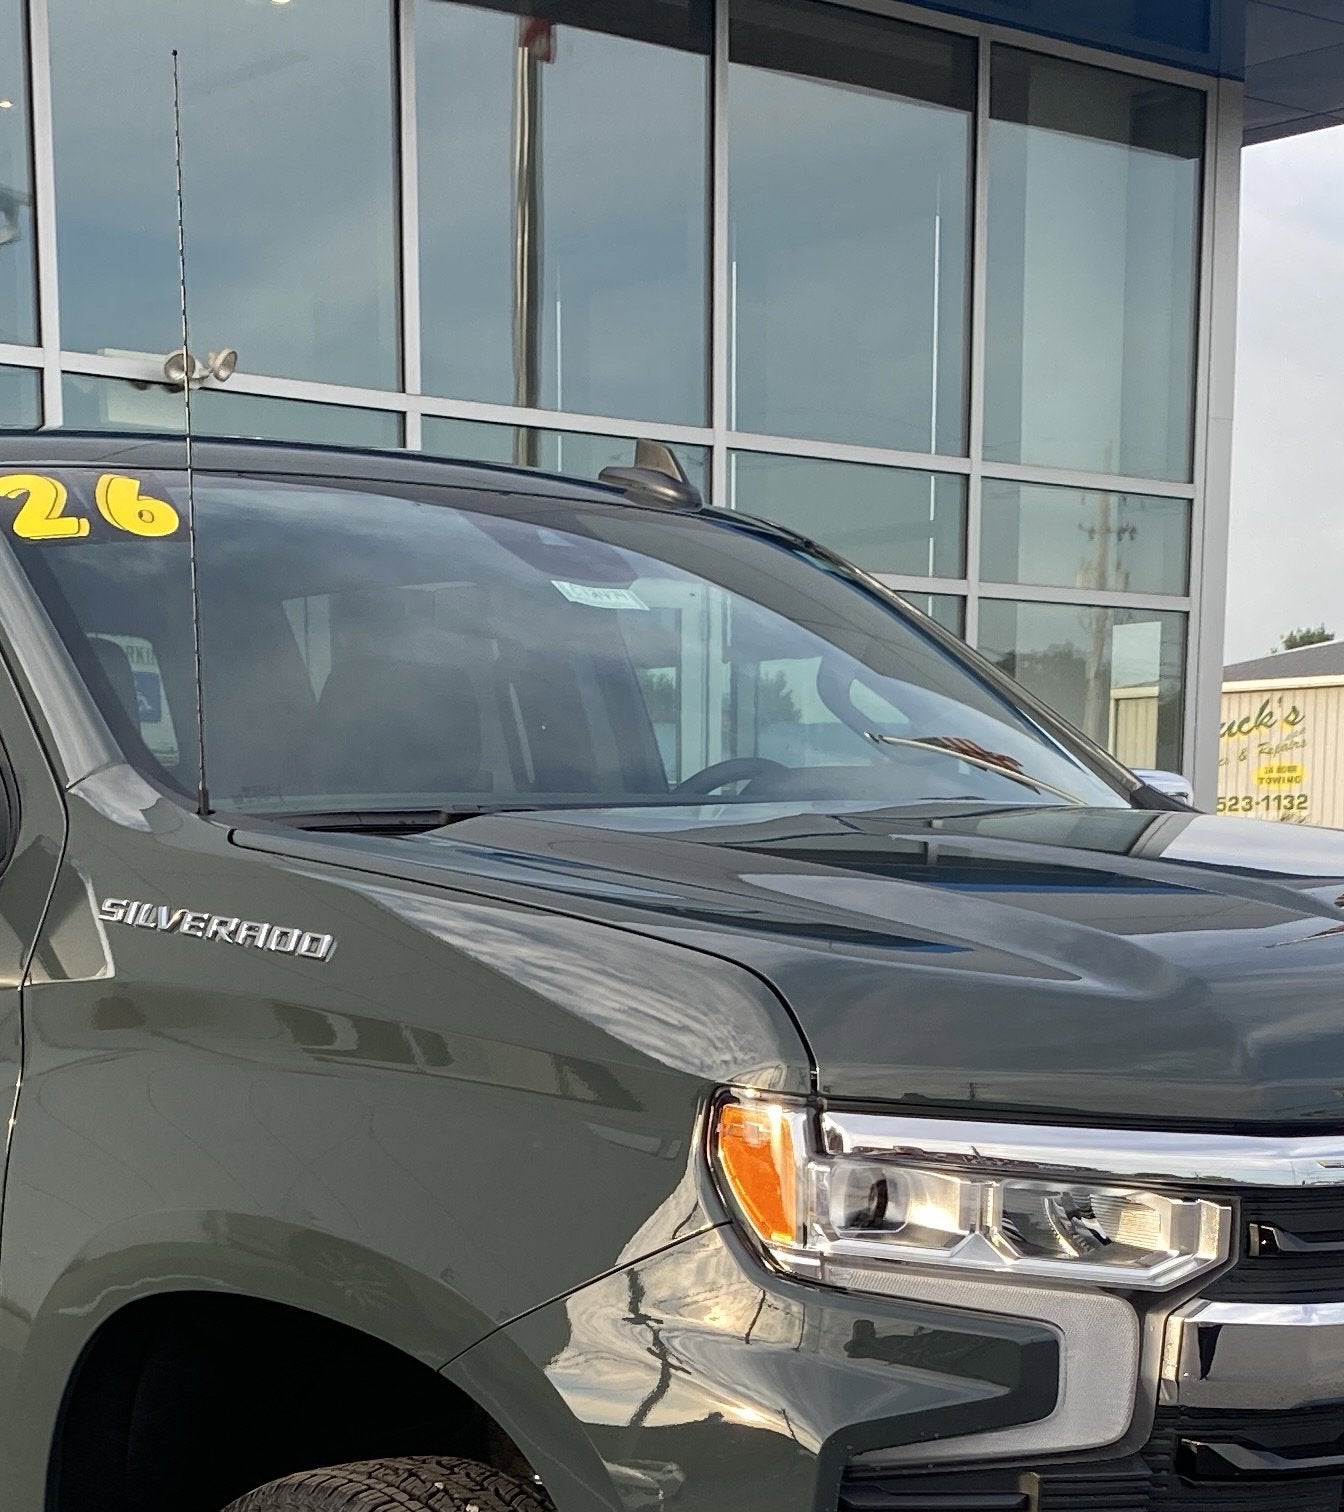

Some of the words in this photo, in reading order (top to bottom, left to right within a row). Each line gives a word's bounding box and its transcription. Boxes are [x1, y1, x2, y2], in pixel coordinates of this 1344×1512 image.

[1219, 695, 1306, 739] uck's
[1257, 775, 1303, 785] TOWING
[1217, 793, 1309, 813] 523-1132
[98, 897, 338, 963] SILVERADO
